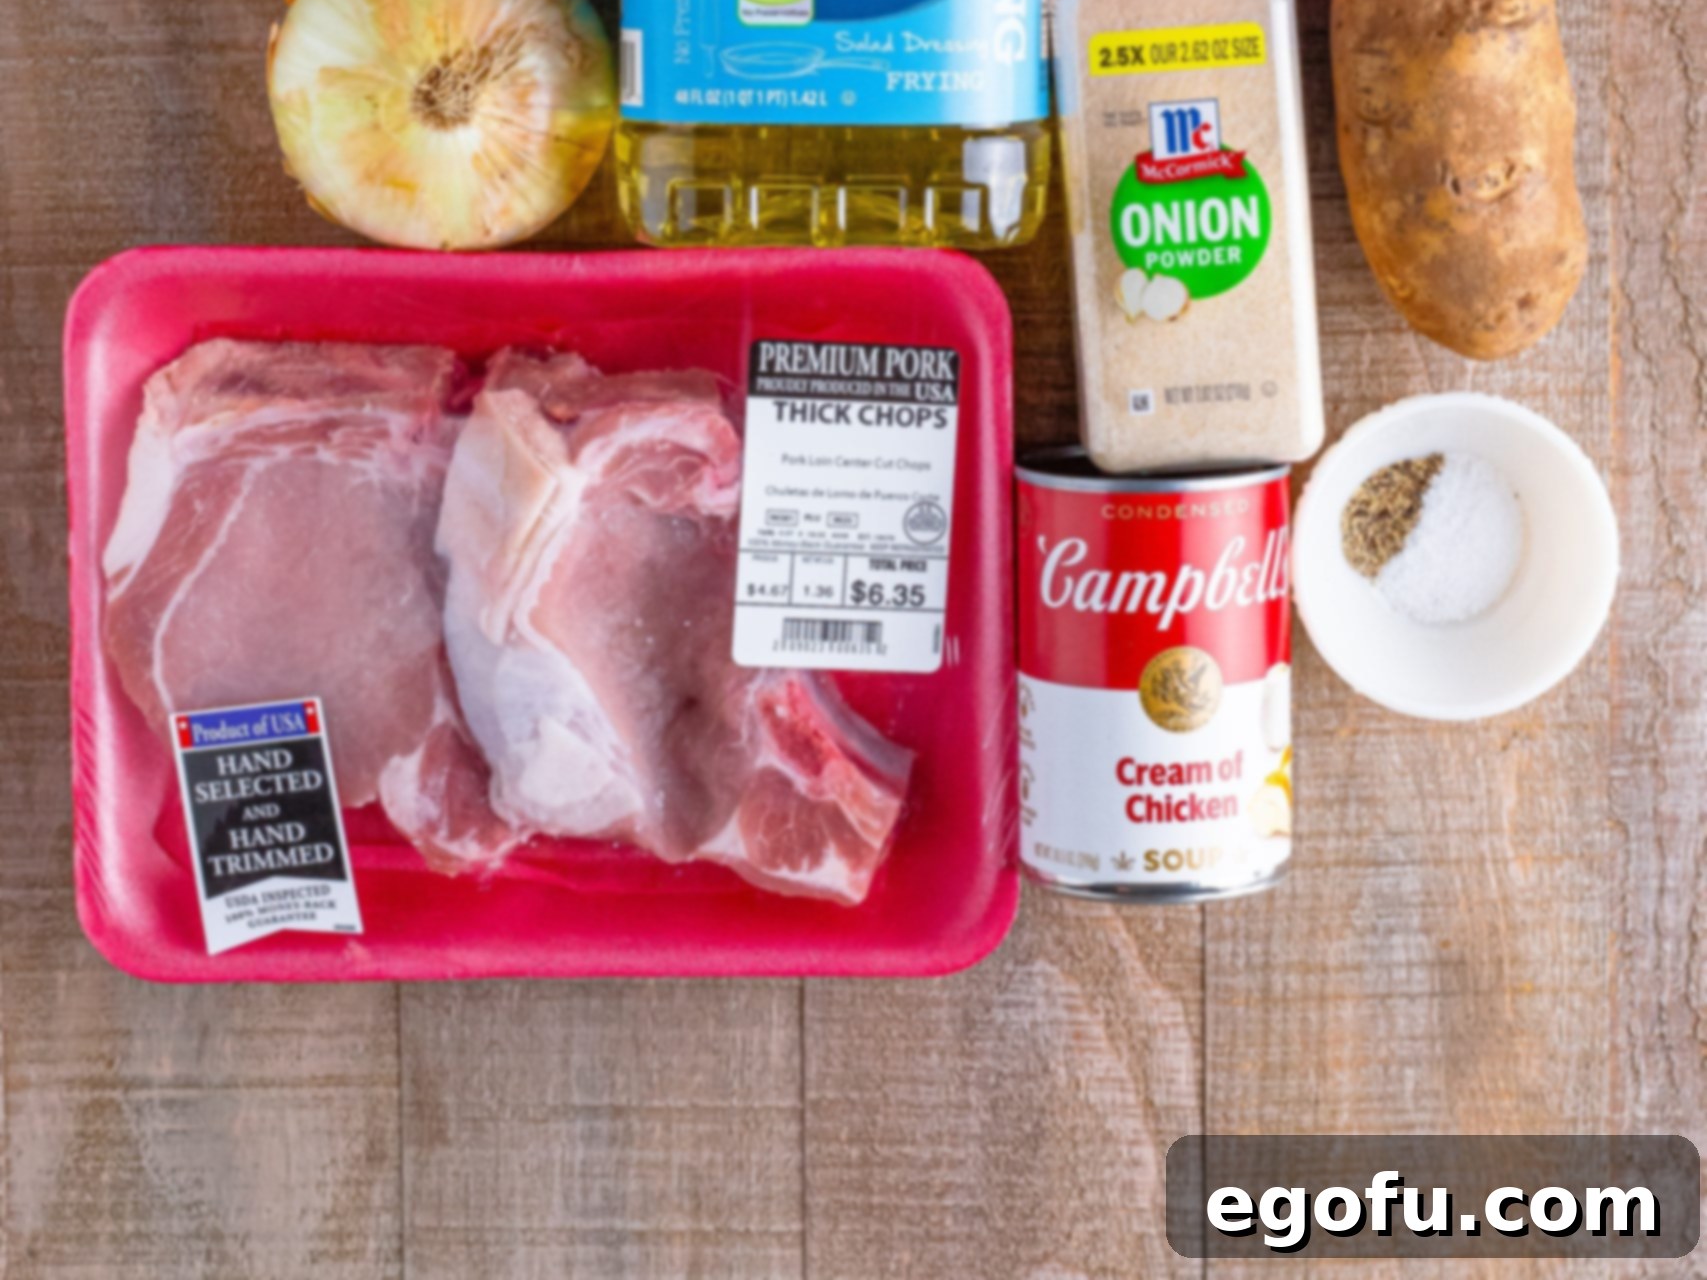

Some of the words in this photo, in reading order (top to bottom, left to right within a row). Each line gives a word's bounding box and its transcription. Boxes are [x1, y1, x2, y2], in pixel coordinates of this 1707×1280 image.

[834, 30, 894, 53] Salad
[1098, 44, 1145, 69] 2.5X
[1150, 41, 1177, 65] OUR
[1179, 39, 1209, 63] 2.62
[1211, 37, 1230, 61] OZ
[1231, 34, 1260, 59] SIZE
[885, 71, 986, 93] FRYING
[1141, 155, 1233, 181] McCormick
[1119, 195, 1260, 248] ONION
[1145, 246, 1243, 270] POWDER
[758, 341, 883, 378] PREMIUM
[885, 347, 954, 381] PORK
[810, 378, 871, 396] PRODUCED
[873, 381, 886, 396] IN
[887, 381, 910, 398] THE
[914, 382, 955, 402] USA
[773, 401, 852, 426] THICK
[857, 404, 948, 430] CHOPS
[781, 453, 806, 466] Pork
[1101, 498, 1250, 521] CONDENSED
[850, 577, 926, 609] $6.35
[192, 720, 251, 744] Product
[252, 716, 269, 736] of
[269, 712, 306, 734] USA
[215, 749, 294, 777] HAND
[1115, 756, 1213, 787] Cream
[1217, 749, 1245, 781] of
[194, 769, 324, 804] SELECTED
[242, 802, 281, 821] AND
[1124, 793, 1239, 825] Chicken
[228, 822, 307, 850] HAND
[207, 842, 335, 878] TRIMMED
[1142, 845, 1223, 873] SOUP
[224, 893, 258, 909] USDA
[260, 883, 331, 904] INSPECTED
